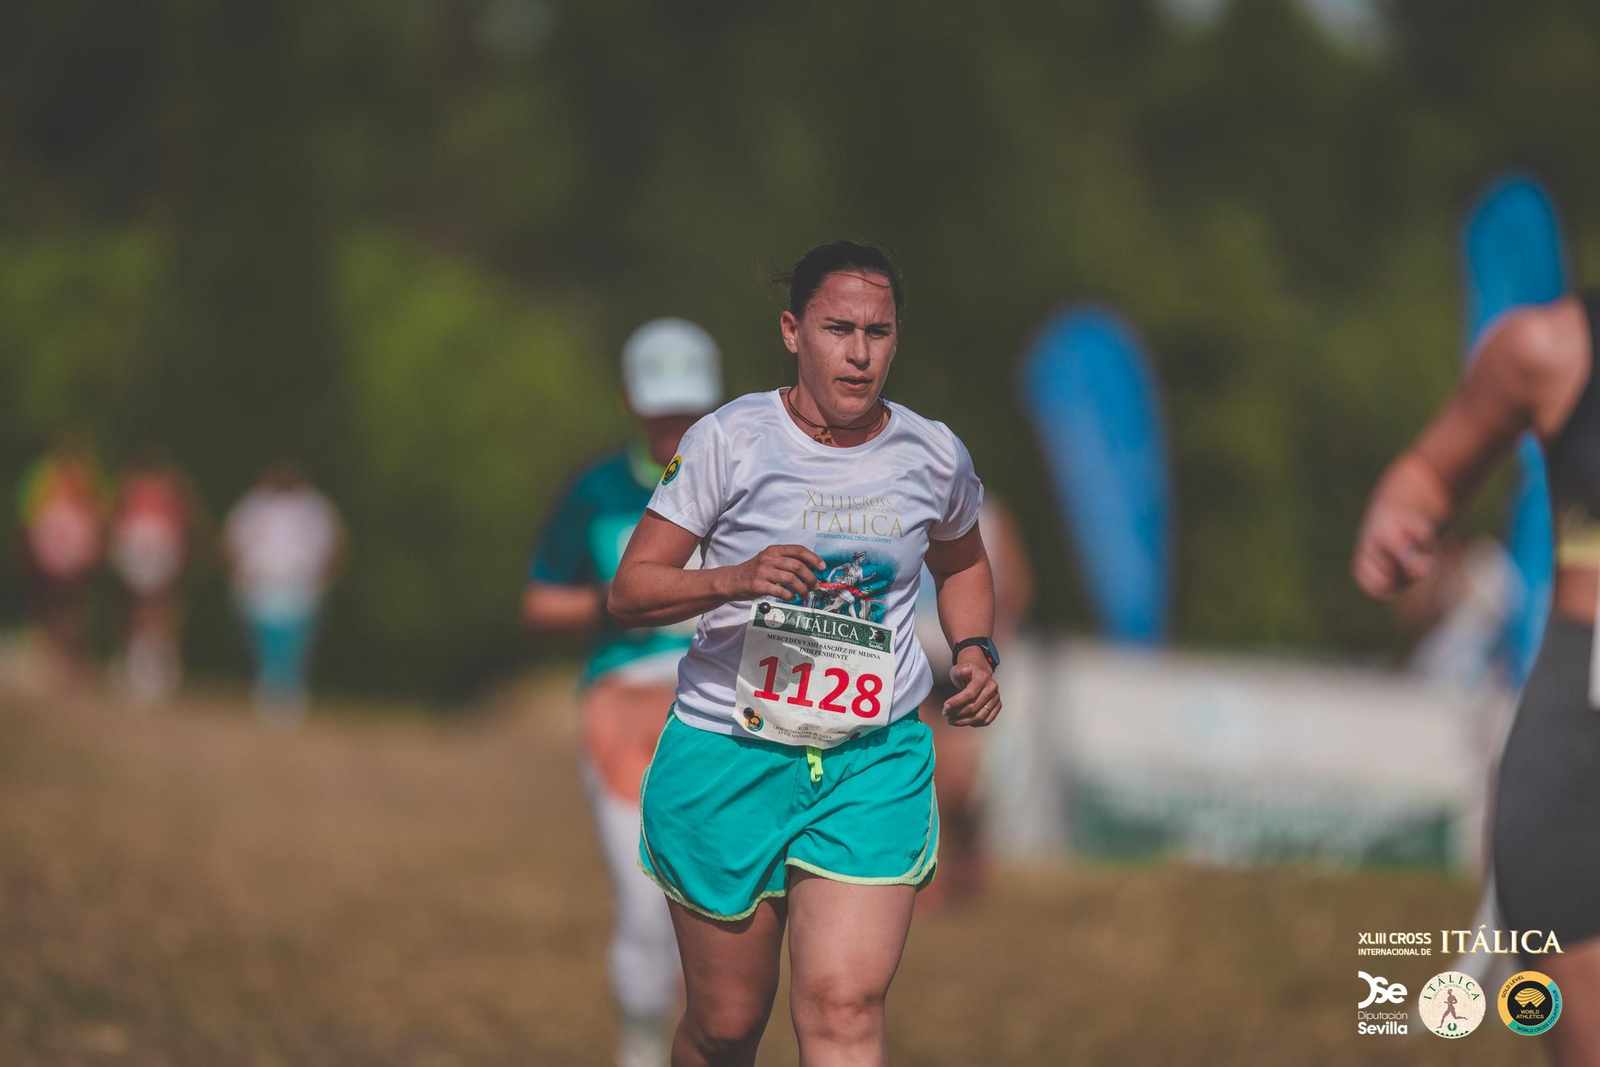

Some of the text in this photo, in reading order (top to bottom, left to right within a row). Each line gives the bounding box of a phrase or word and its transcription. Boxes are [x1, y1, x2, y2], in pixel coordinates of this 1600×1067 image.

[805, 490, 892, 510] XLIII CROSS
[801, 508, 904, 538] ITÁLICA
[795, 615, 859, 641] ITÁLICA
[767, 634, 802, 645] MERCEDES
[819, 643, 848, 654] SÁNCHEZ
[848, 648, 857, 656] DE
[858, 651, 881, 660] MEDINA
[800, 647, 848, 661] INDEPENDIENTE
[754, 656, 883, 718] 1128
